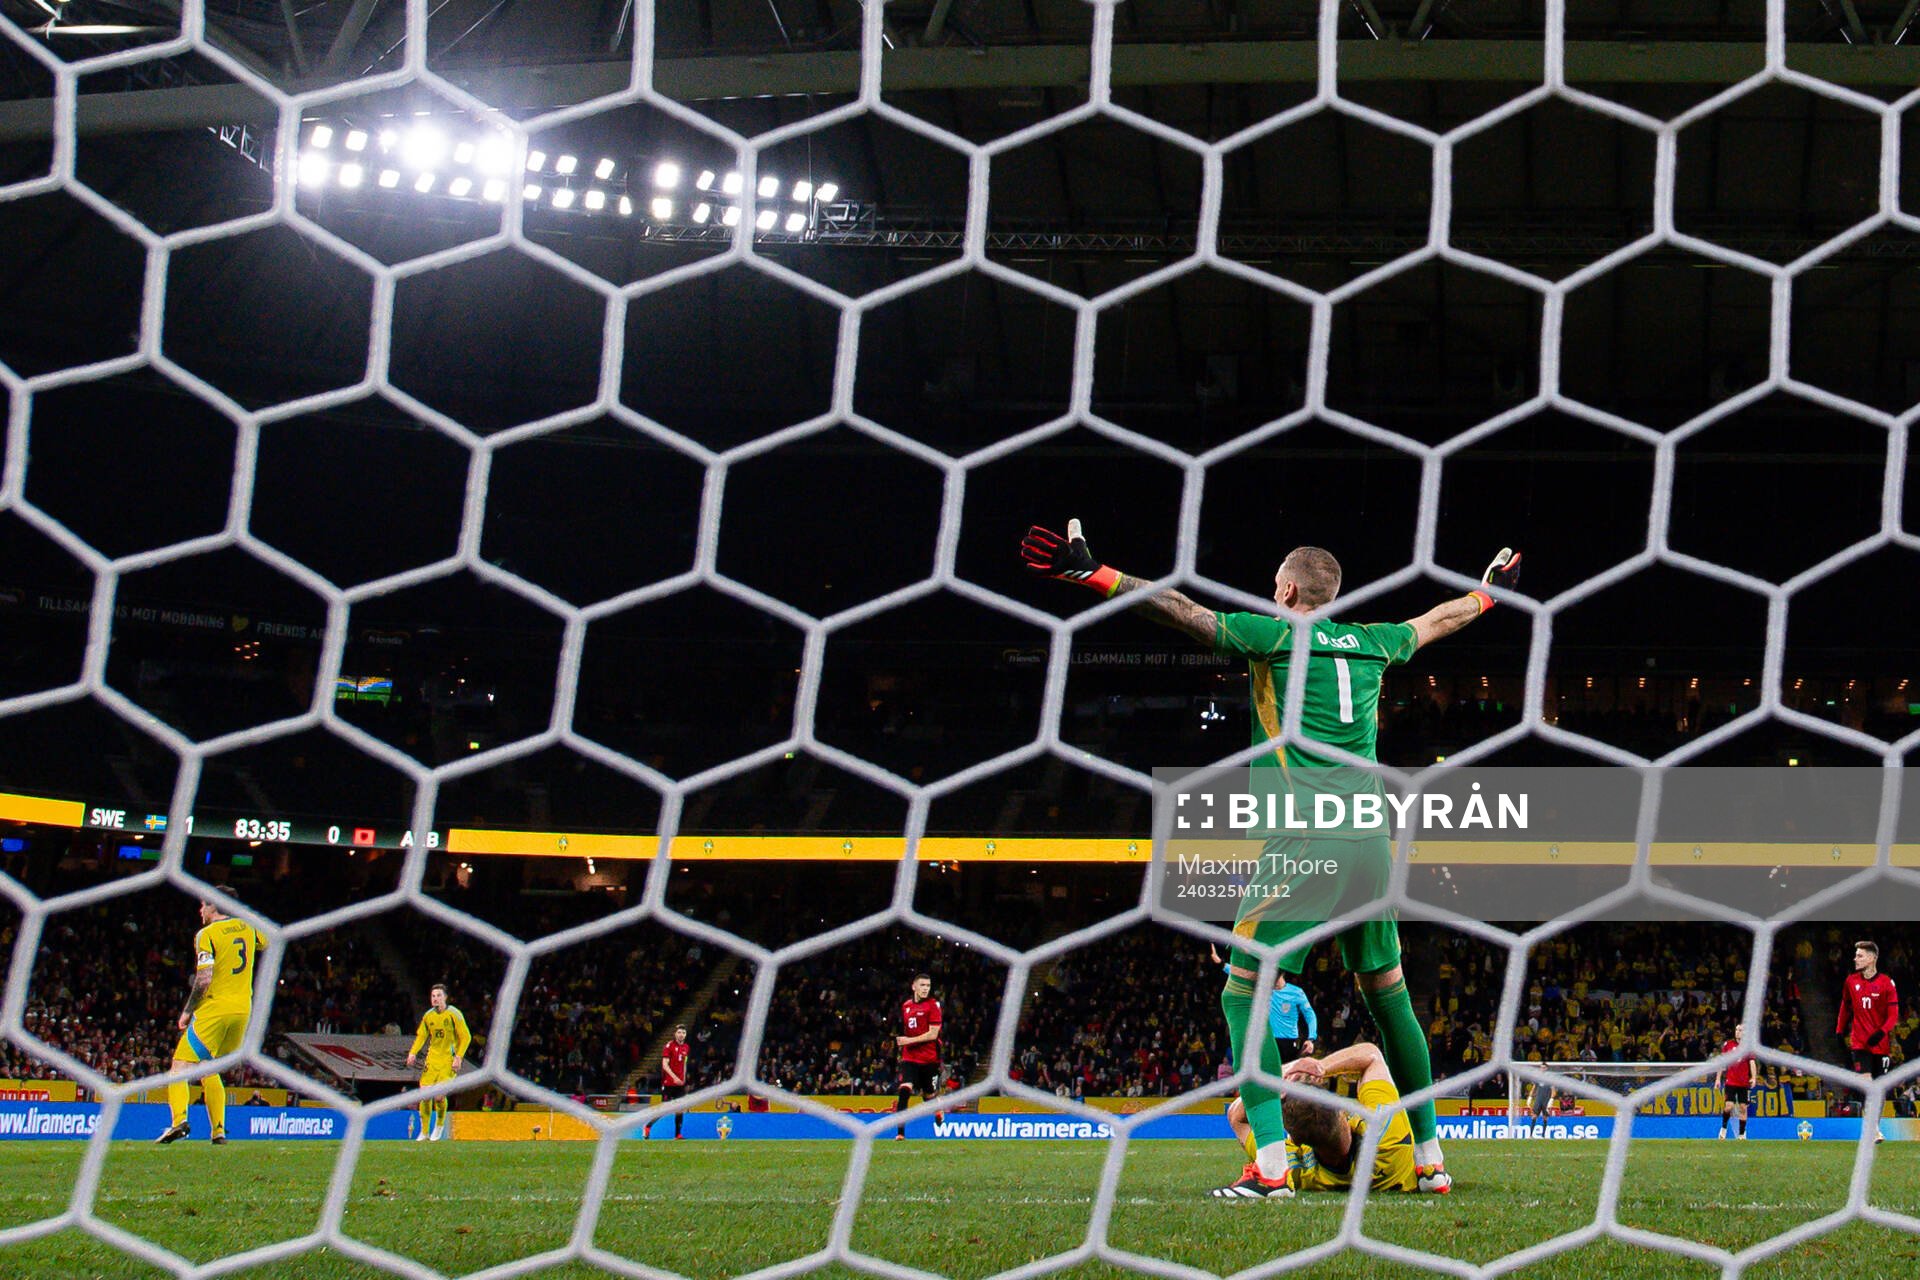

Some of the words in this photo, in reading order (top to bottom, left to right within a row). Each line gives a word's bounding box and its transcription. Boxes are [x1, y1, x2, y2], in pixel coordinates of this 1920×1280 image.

[1145, 653, 1168, 666] MOT
[1334, 657, 1355, 724] 1
[90, 807, 126, 829] SWE
[184, 815, 195, 836] 1
[234, 817, 292, 843] 83:35
[327, 825, 341, 845] 0
[400, 829, 440, 849] AB
[232, 937, 248, 975] 3
[908, 1017, 918, 1029] 21
[250, 1112, 334, 1135] www.liramera.se
